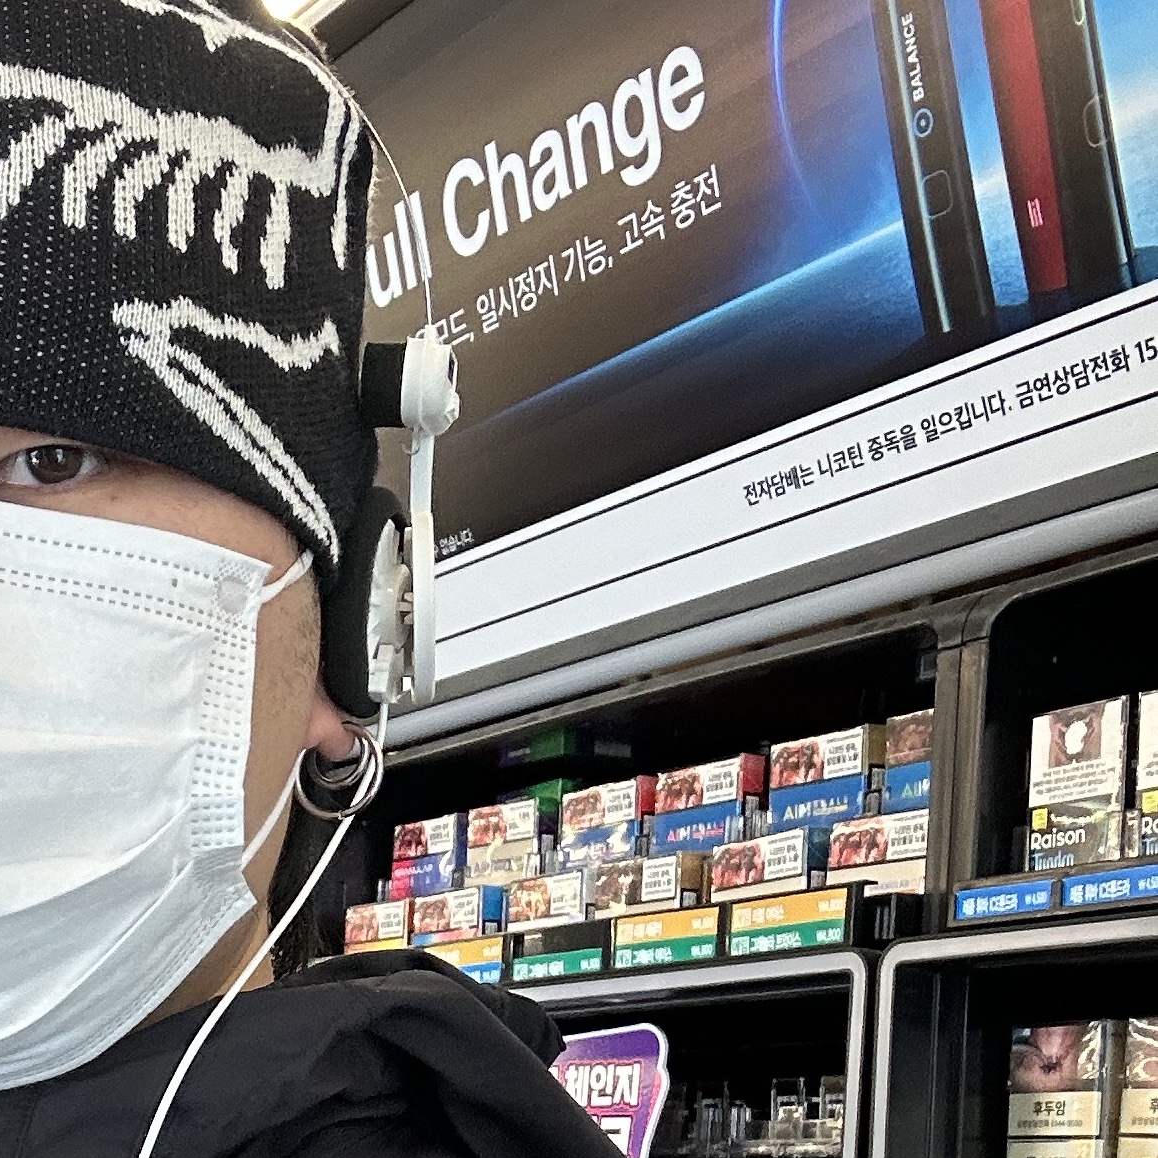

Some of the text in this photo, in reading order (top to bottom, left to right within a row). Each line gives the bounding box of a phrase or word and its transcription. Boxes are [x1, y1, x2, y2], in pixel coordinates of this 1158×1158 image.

[901, 12, 925, 102] BALANCE
[442, 45, 706, 257] Change
[476, 254, 559, 334] 일시정지
[561, 236, 614, 282] 기능,
[617, 199, 666, 255] 고속
[670, 163, 722, 229] 충전
[743, 463, 815, 506] 전자담배는
[817, 442, 864, 476] 니코틴
[867, 424, 917, 461] 중독을
[920, 389, 1013, 442] 일으킵니다.
[1015, 344, 1130, 408] 금연상담전화
[1030, 828, 1086, 851] Raison
